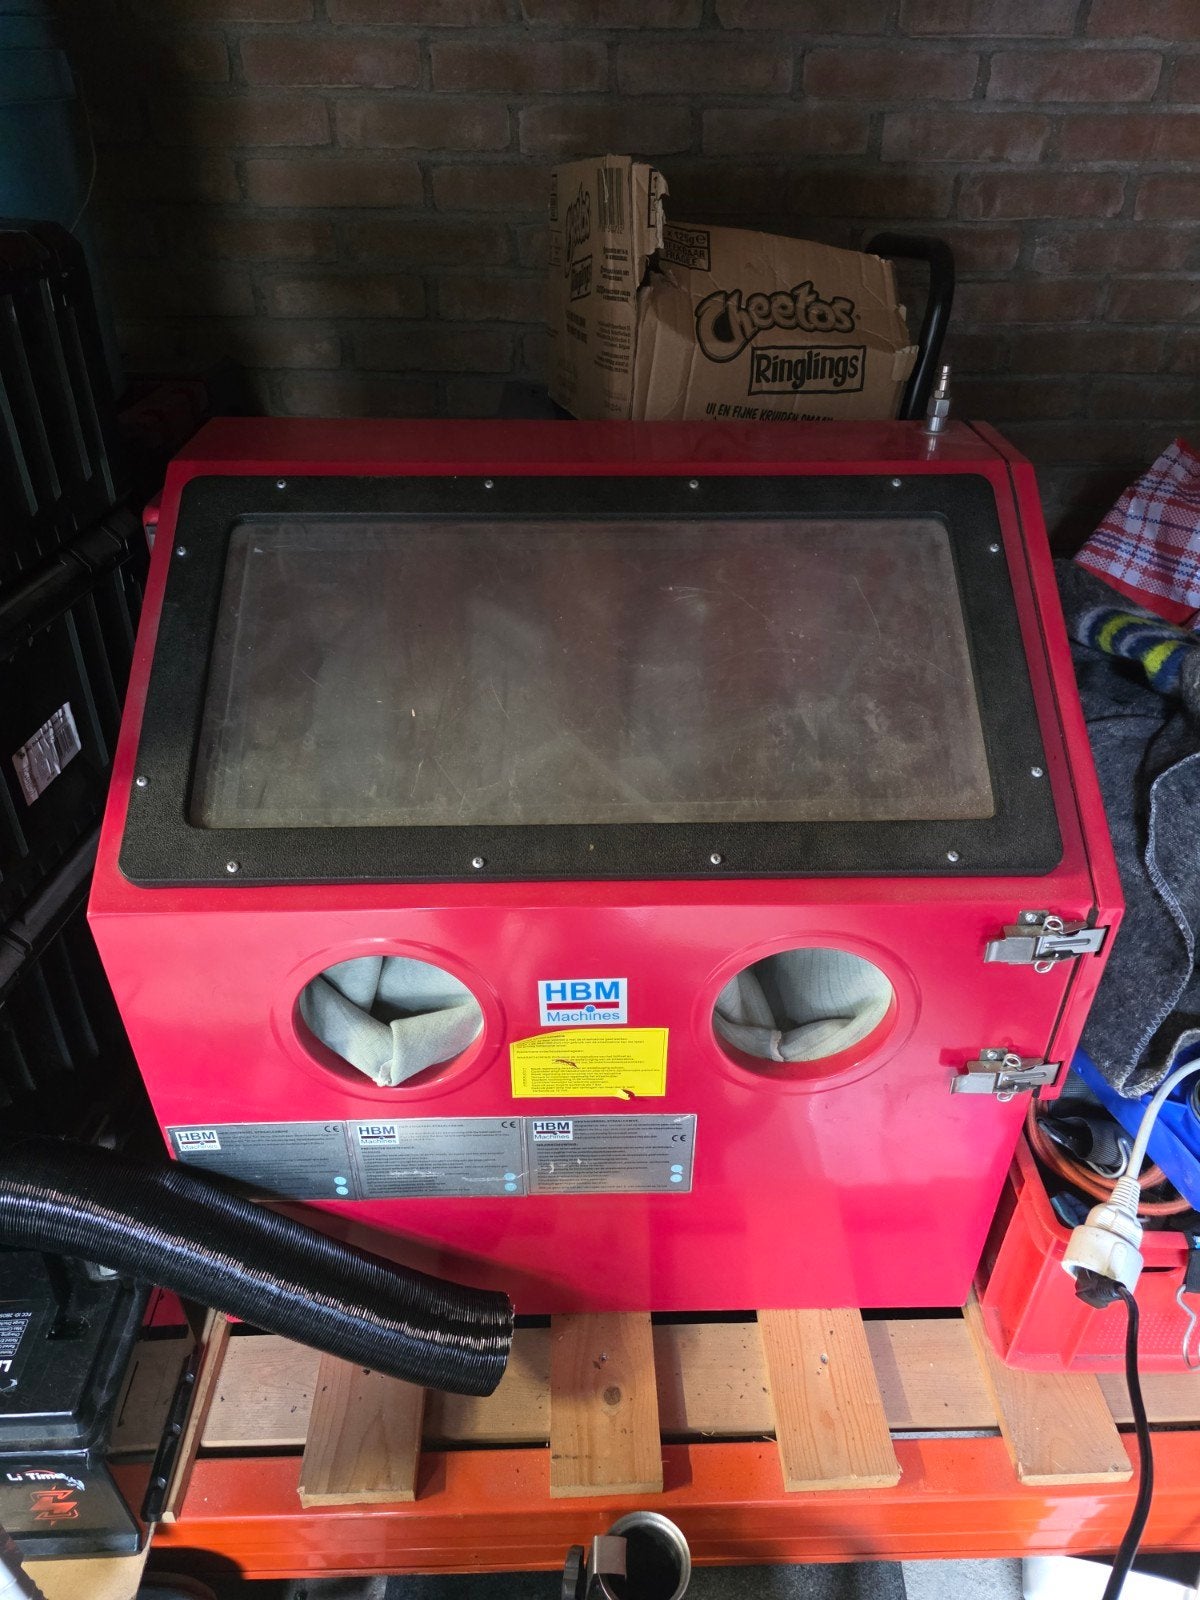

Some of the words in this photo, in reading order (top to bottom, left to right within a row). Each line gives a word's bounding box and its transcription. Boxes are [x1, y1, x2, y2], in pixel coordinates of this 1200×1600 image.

[694, 280, 856, 363] Cheetos
[755, 350, 860, 389] Ringlings
[718, 404, 731, 416] EN
[732, 405, 760, 420] FIJNE
[545, 980, 620, 1002] HBM
[547, 1010, 620, 1022] Machines
[358, 1126, 395, 1136] HBM
[533, 1122, 570, 1131] HBM
[178, 1131, 216, 1141] HBM
[6, 1473, 23, 1481] Li
